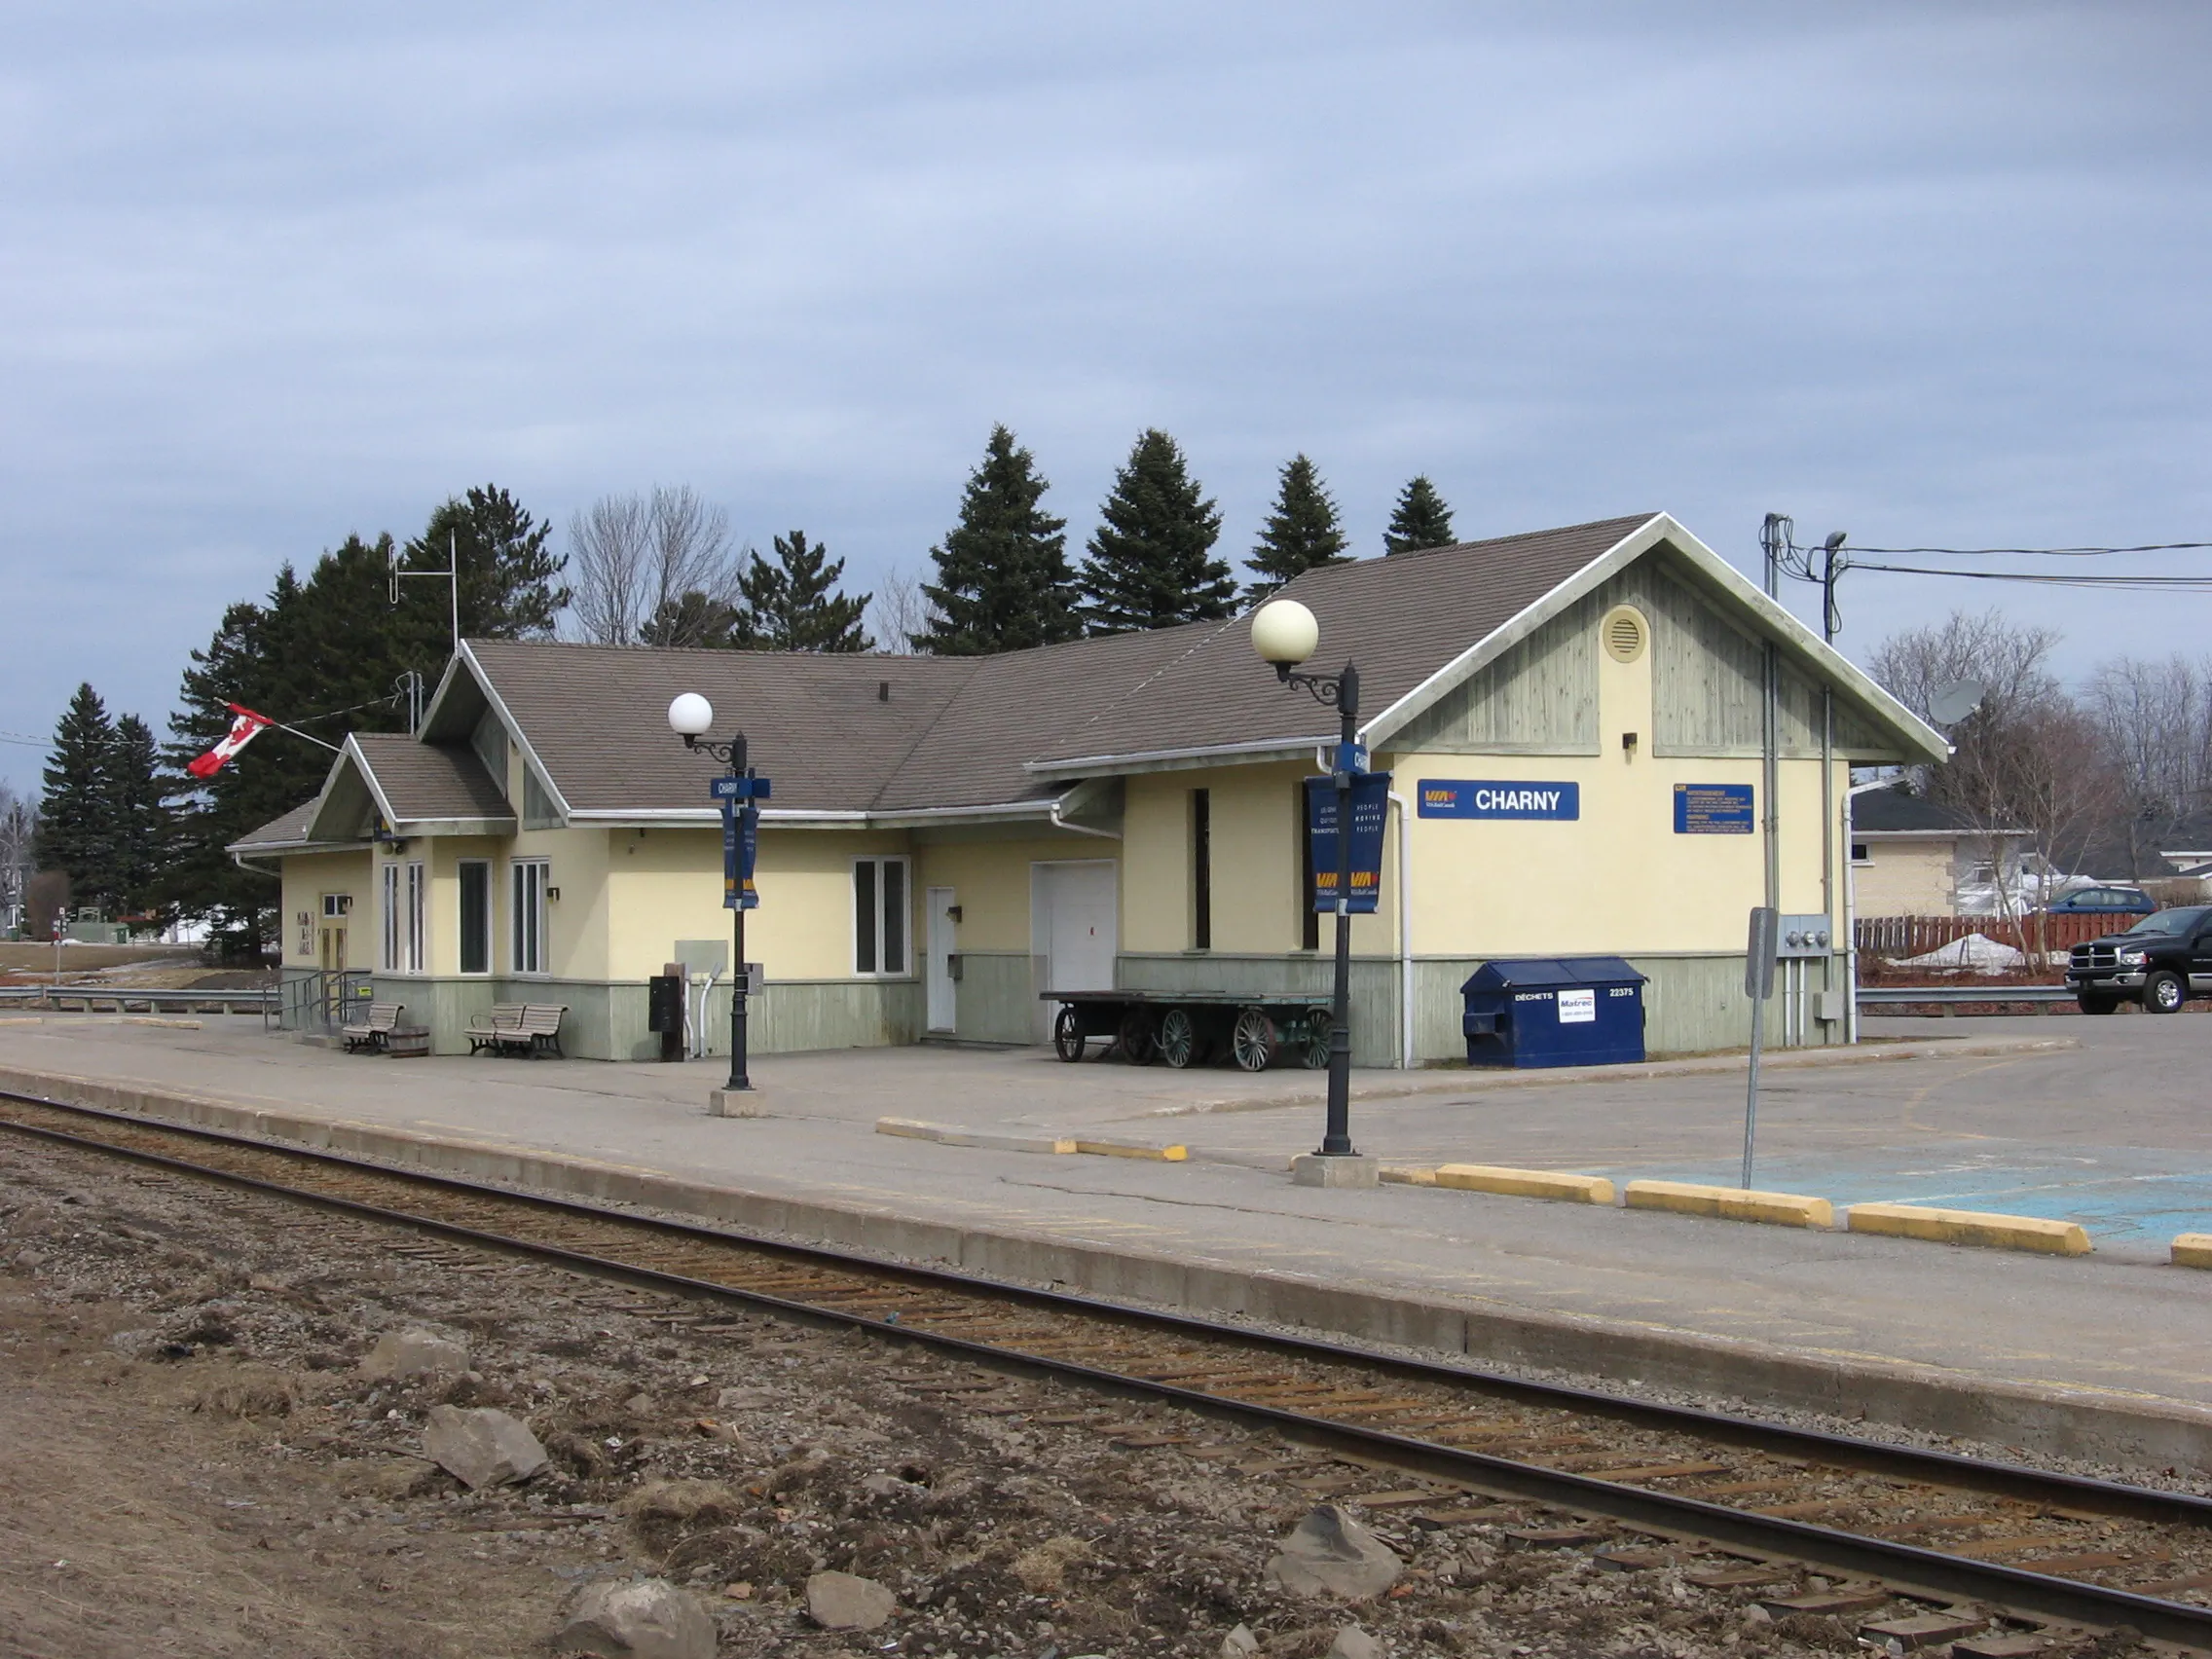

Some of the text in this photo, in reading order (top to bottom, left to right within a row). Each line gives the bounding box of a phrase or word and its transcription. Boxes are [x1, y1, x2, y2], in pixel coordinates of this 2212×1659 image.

[1424, 790, 1449, 801] VIA
[1475, 789, 1561, 811] CHARNY
[1316, 872, 1338, 888] VIA
[1350, 871, 1371, 887] VIA
[1609, 987, 1634, 997] 22375
